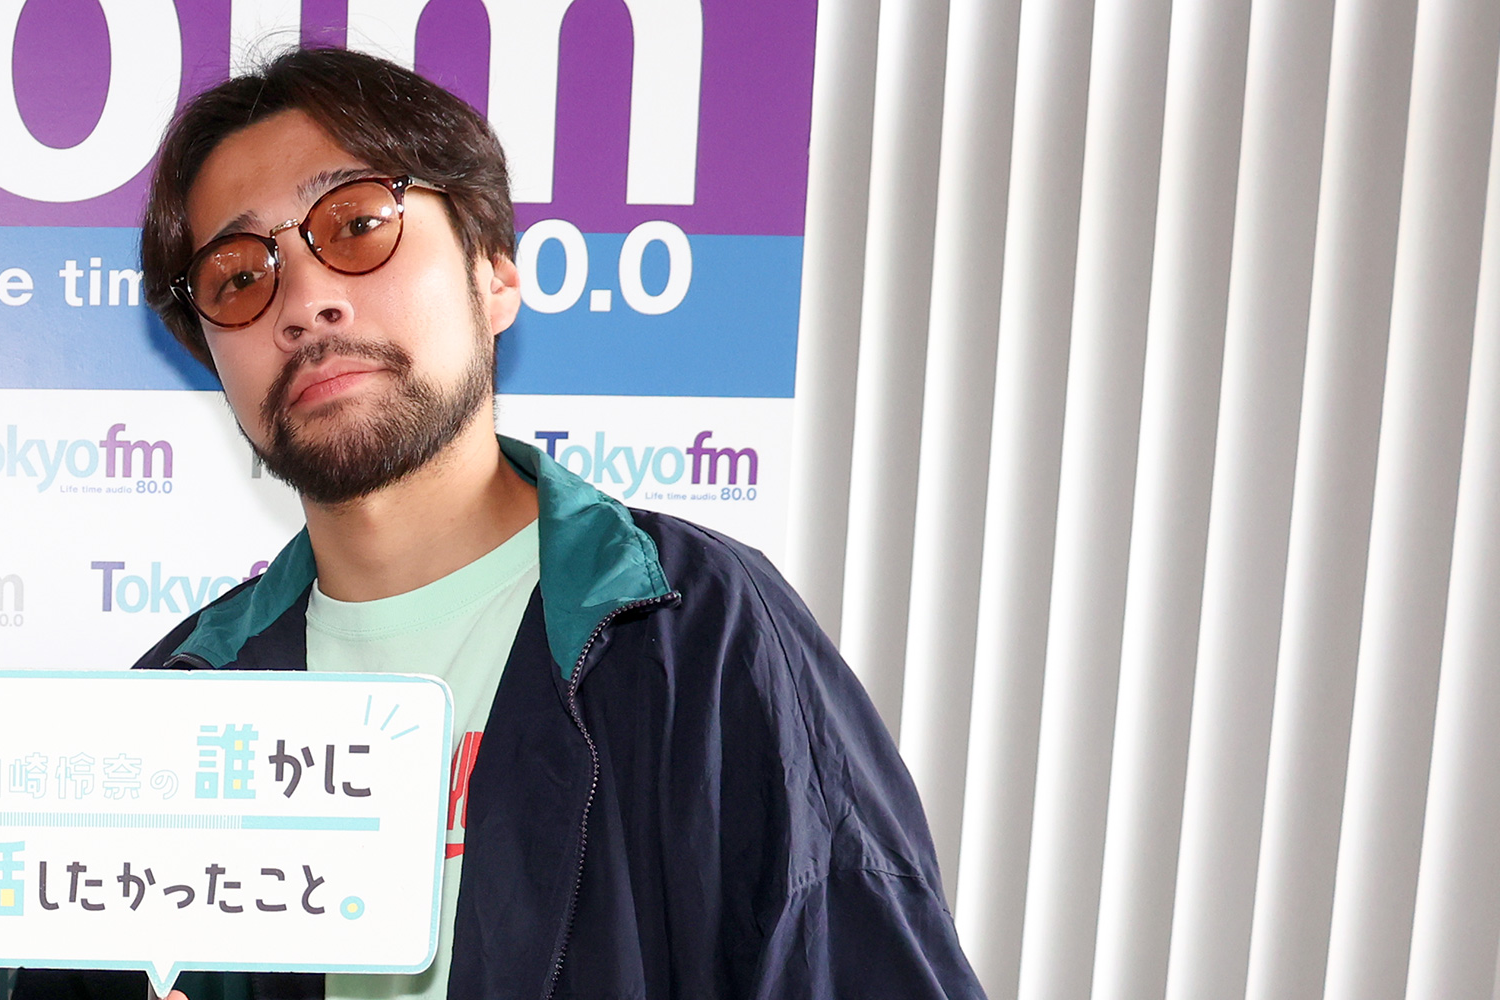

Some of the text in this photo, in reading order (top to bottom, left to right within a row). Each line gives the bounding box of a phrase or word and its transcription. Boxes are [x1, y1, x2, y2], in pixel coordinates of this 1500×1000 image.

[59, 257, 143, 307] tim
[515, 218, 693, 315] 0.0
[535, 430, 758, 500] Tokyofm
[60, 480, 173, 494] Life time audio 80.0
[720, 488, 757, 500] 80.0
